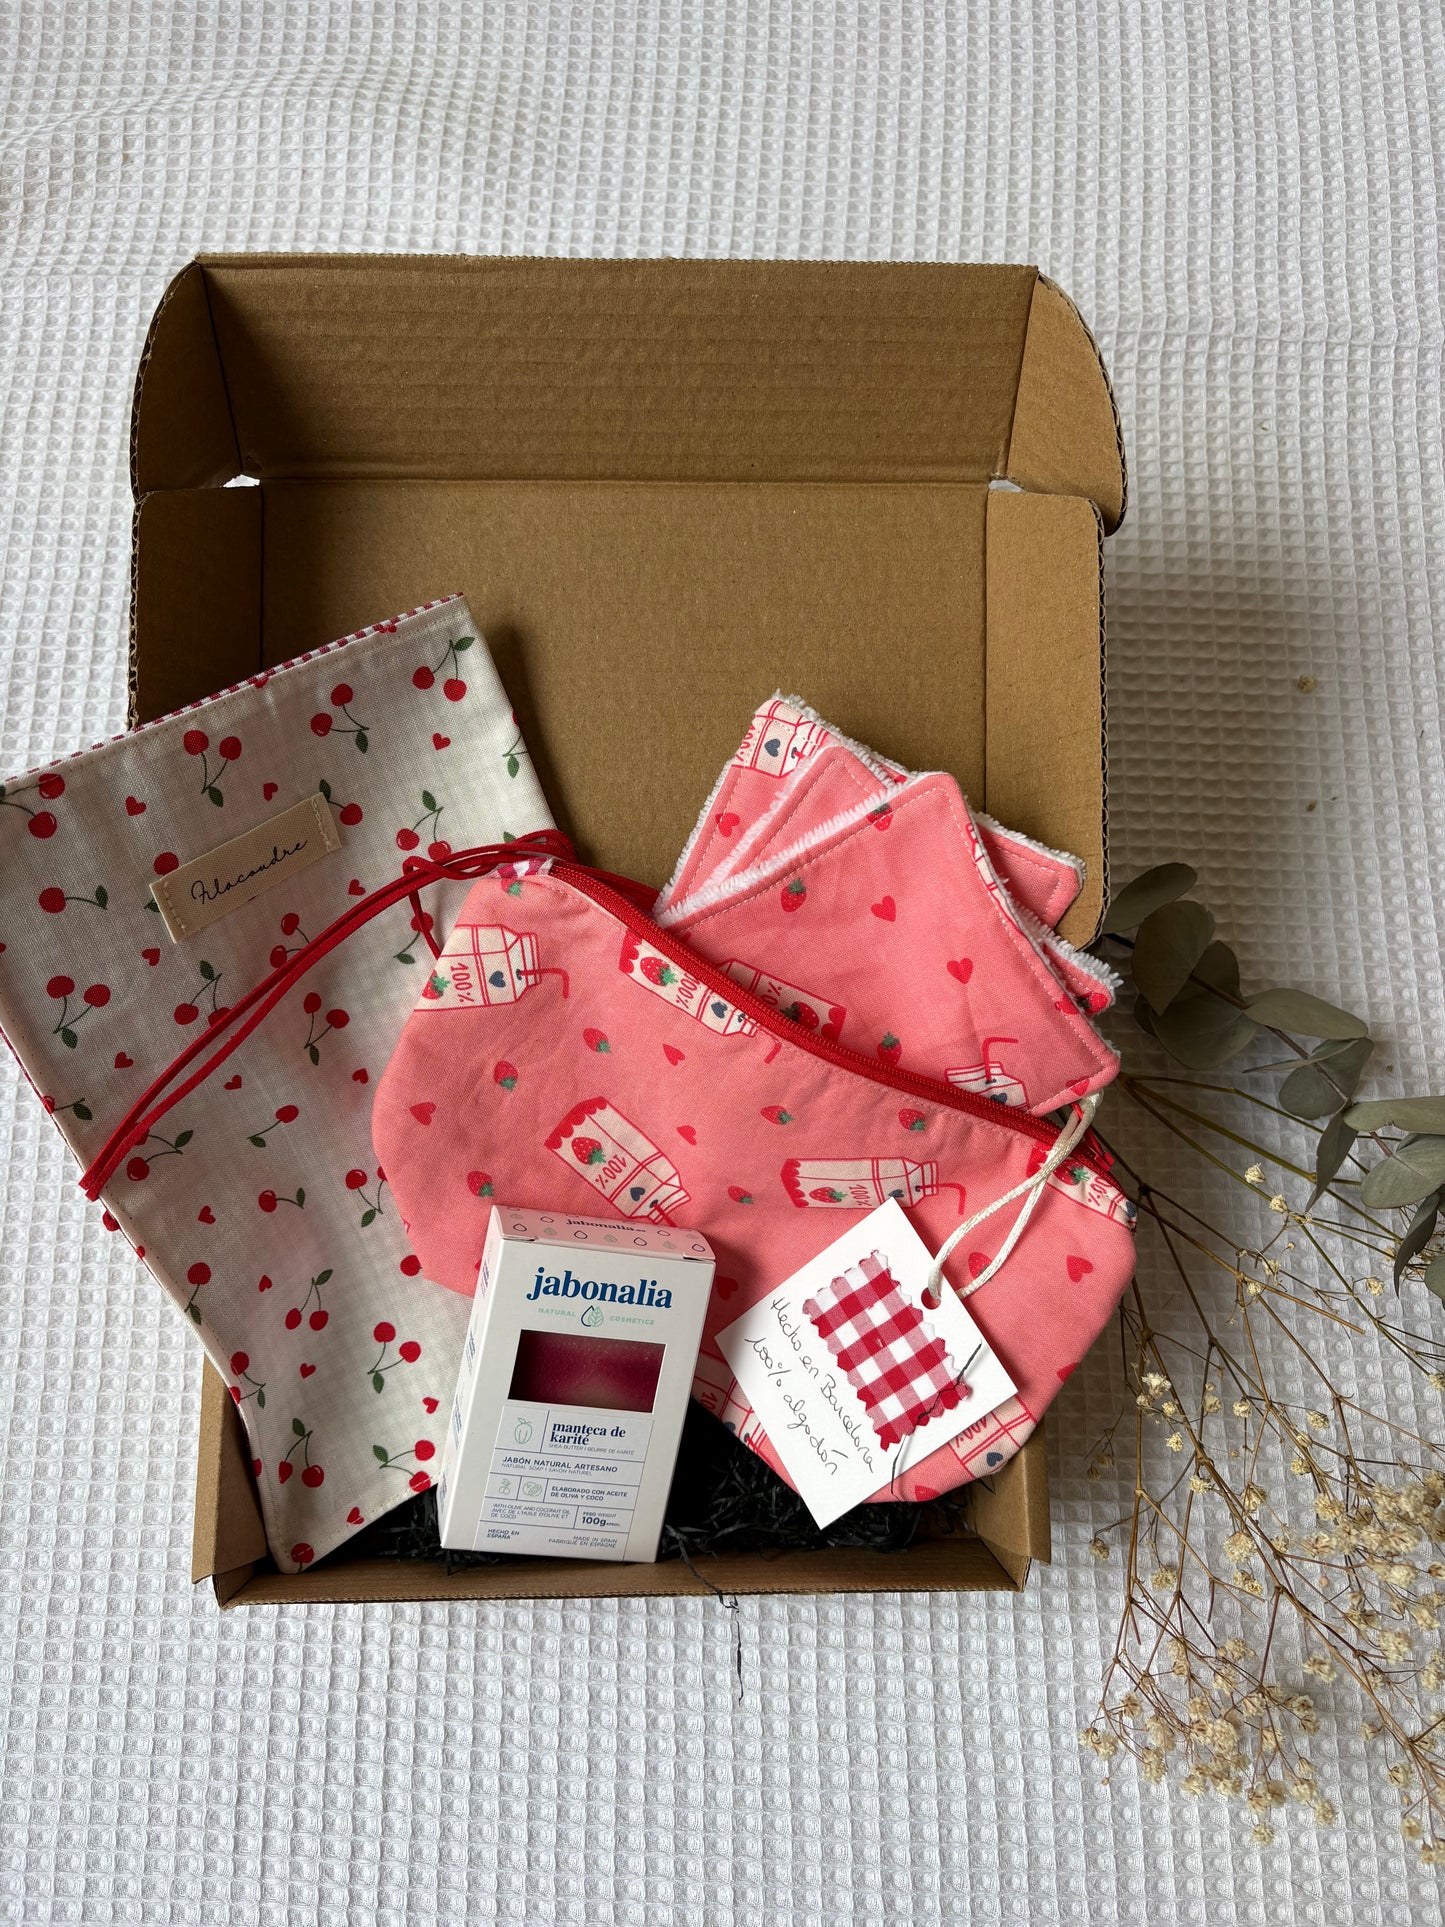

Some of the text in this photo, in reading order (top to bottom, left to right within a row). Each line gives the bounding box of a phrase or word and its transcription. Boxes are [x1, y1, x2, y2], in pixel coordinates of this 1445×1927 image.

[450, 962, 475, 1002] 100%
[595, 1154, 627, 1190] 100%
[849, 1184, 872, 1207] 100%
[526, 1267, 673, 1309] jabonalia
[538, 1307, 655, 1326] NATURAL COSMETICS
[770, 1296, 874, 1474] Hecho en Barcelona
[744, 1337, 849, 1476] 100% algodón
[550, 1431, 589, 1445] karité
[552, 1423, 626, 1438] manteca de
[502, 1456, 618, 1473] JABÓN NATURAL ARTESANO
[552, 1485, 590, 1495] ELABORADO
[582, 1516, 607, 1527] 100g
